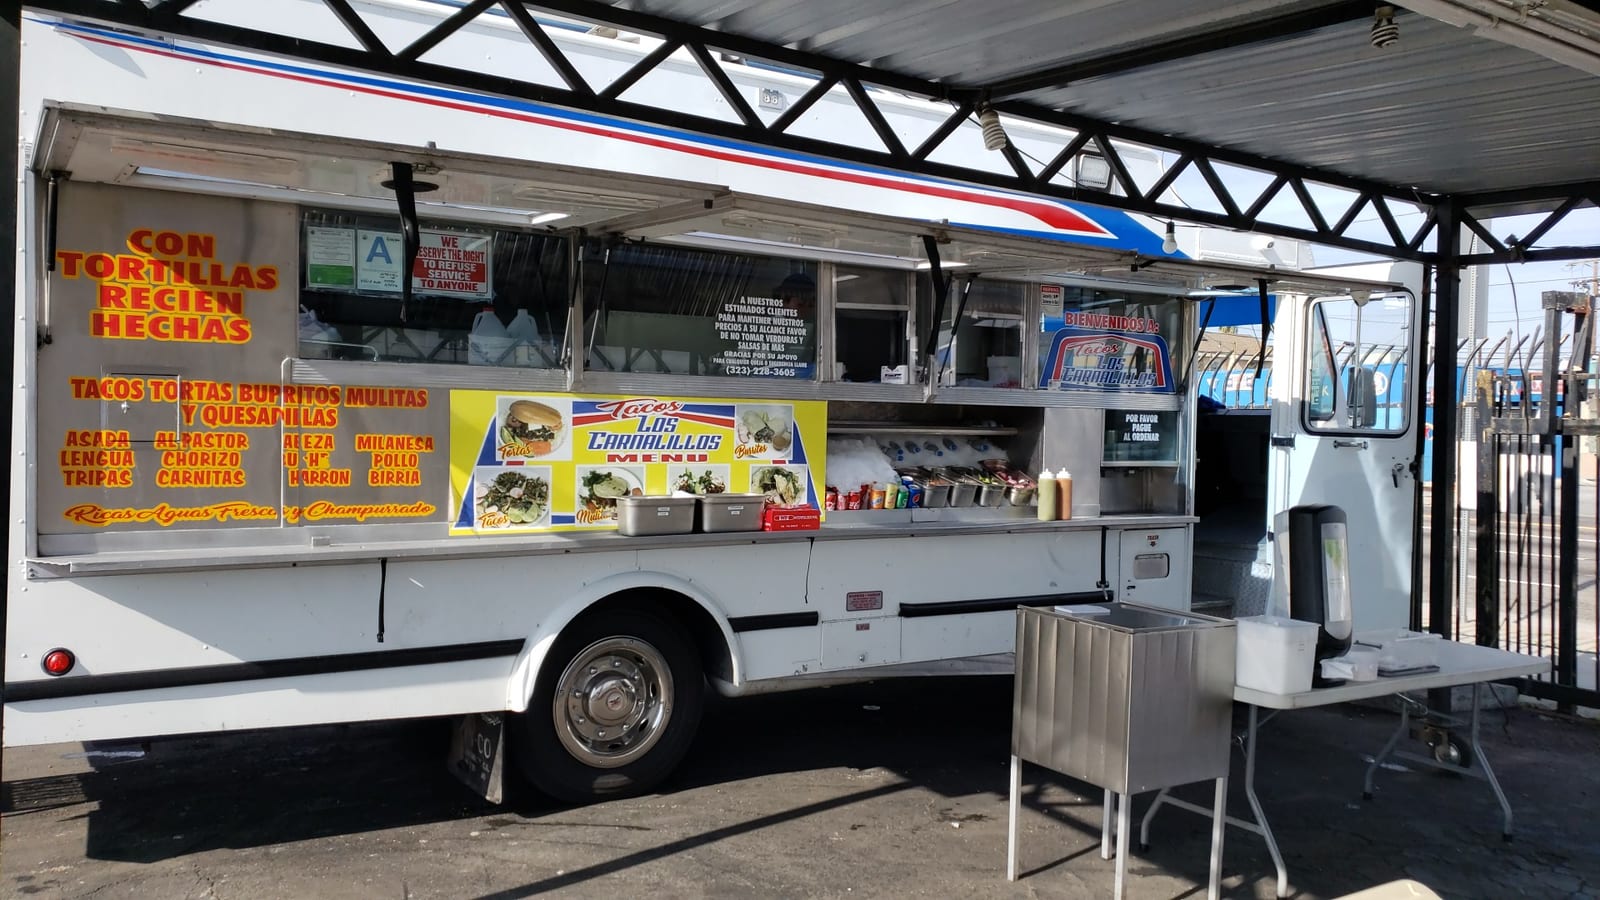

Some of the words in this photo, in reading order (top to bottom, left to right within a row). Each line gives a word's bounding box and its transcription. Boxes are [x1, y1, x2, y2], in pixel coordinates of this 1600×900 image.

[127, 230, 214, 258] CON
[366, 236, 392, 264] A
[441, 236, 458, 248] WE
[448, 249, 461, 260] THE
[464, 250, 484, 262] RIGHT
[57, 251, 278, 289] TORTILLAS
[422, 260, 435, 268] TO
[438, 261, 476, 272] REFUSE
[428, 270, 471, 280] SERVICE
[421, 280, 434, 288] TO
[437, 282, 478, 291] ANYONE
[100, 284, 242, 315] RECIEN
[740, 296, 746, 304] A
[747, 297, 783, 307] NUESTROS
[725, 304, 765, 314] ESTIMADOS
[767, 307, 798, 317] CLIENTES
[92, 312, 250, 342] HECHAS
[718, 313, 735, 322] PARA
[738, 315, 772, 325] MANTENER
[773, 317, 804, 327] NUESTROS
[1065, 312, 1145, 332] BIENVENIDOS
[1146, 320, 1159, 333] A:
[715, 322, 742, 331] PRECIOS
[743, 324, 748, 332] A
[760, 326, 785, 334] ALCANCE
[787, 327, 807, 336] FAVOR
[730, 332, 740, 340] NO
[742, 333, 764, 342] TOMAR
[766, 335, 798, 343] VERDURAS
[738, 342, 760, 350] SALSAS
[762, 343, 769, 351] DE
[1066, 341, 1121, 356] Tacos
[1097, 355, 1126, 369] LOS
[1063, 368, 1157, 386] CARNALILLOS
[71, 378, 144, 400] TACOS
[150, 380, 232, 402] TORTAS
[345, 387, 428, 407] MULITAS
[181, 404, 197, 424] Y
[597, 398, 682, 418] Tacos
[637, 415, 679, 432] LOS
[1125, 414, 1139, 423] POR
[1140, 415, 1159, 423] FAVOR
[1132, 423, 1152, 432] PAGUE
[66, 431, 129, 448] ASADA
[156, 432, 177, 448] AL
[181, 432, 248, 449] PASTOR
[356, 435, 433, 450] MILANESA
[587, 432, 722, 450] CARNALILLOS
[1123, 432, 1131, 441] AL
[1132, 432, 1160, 441] ORDENAR
[497, 442, 531, 459] Tortas
[607, 453, 708, 462] MENU
[61, 451, 134, 467] LENGUA
[162, 451, 241, 467] CHORIZO
[373, 452, 418, 468] POLLO
[63, 470, 133, 486] TRIPAS
[156, 470, 246, 487] CARNITAS
[369, 470, 420, 486] BIRRIA
[65, 505, 135, 523] Ricas
[136, 504, 212, 523] Aguas
[307, 501, 432, 520] Champurrado
[479, 511, 508, 528] Tacos
